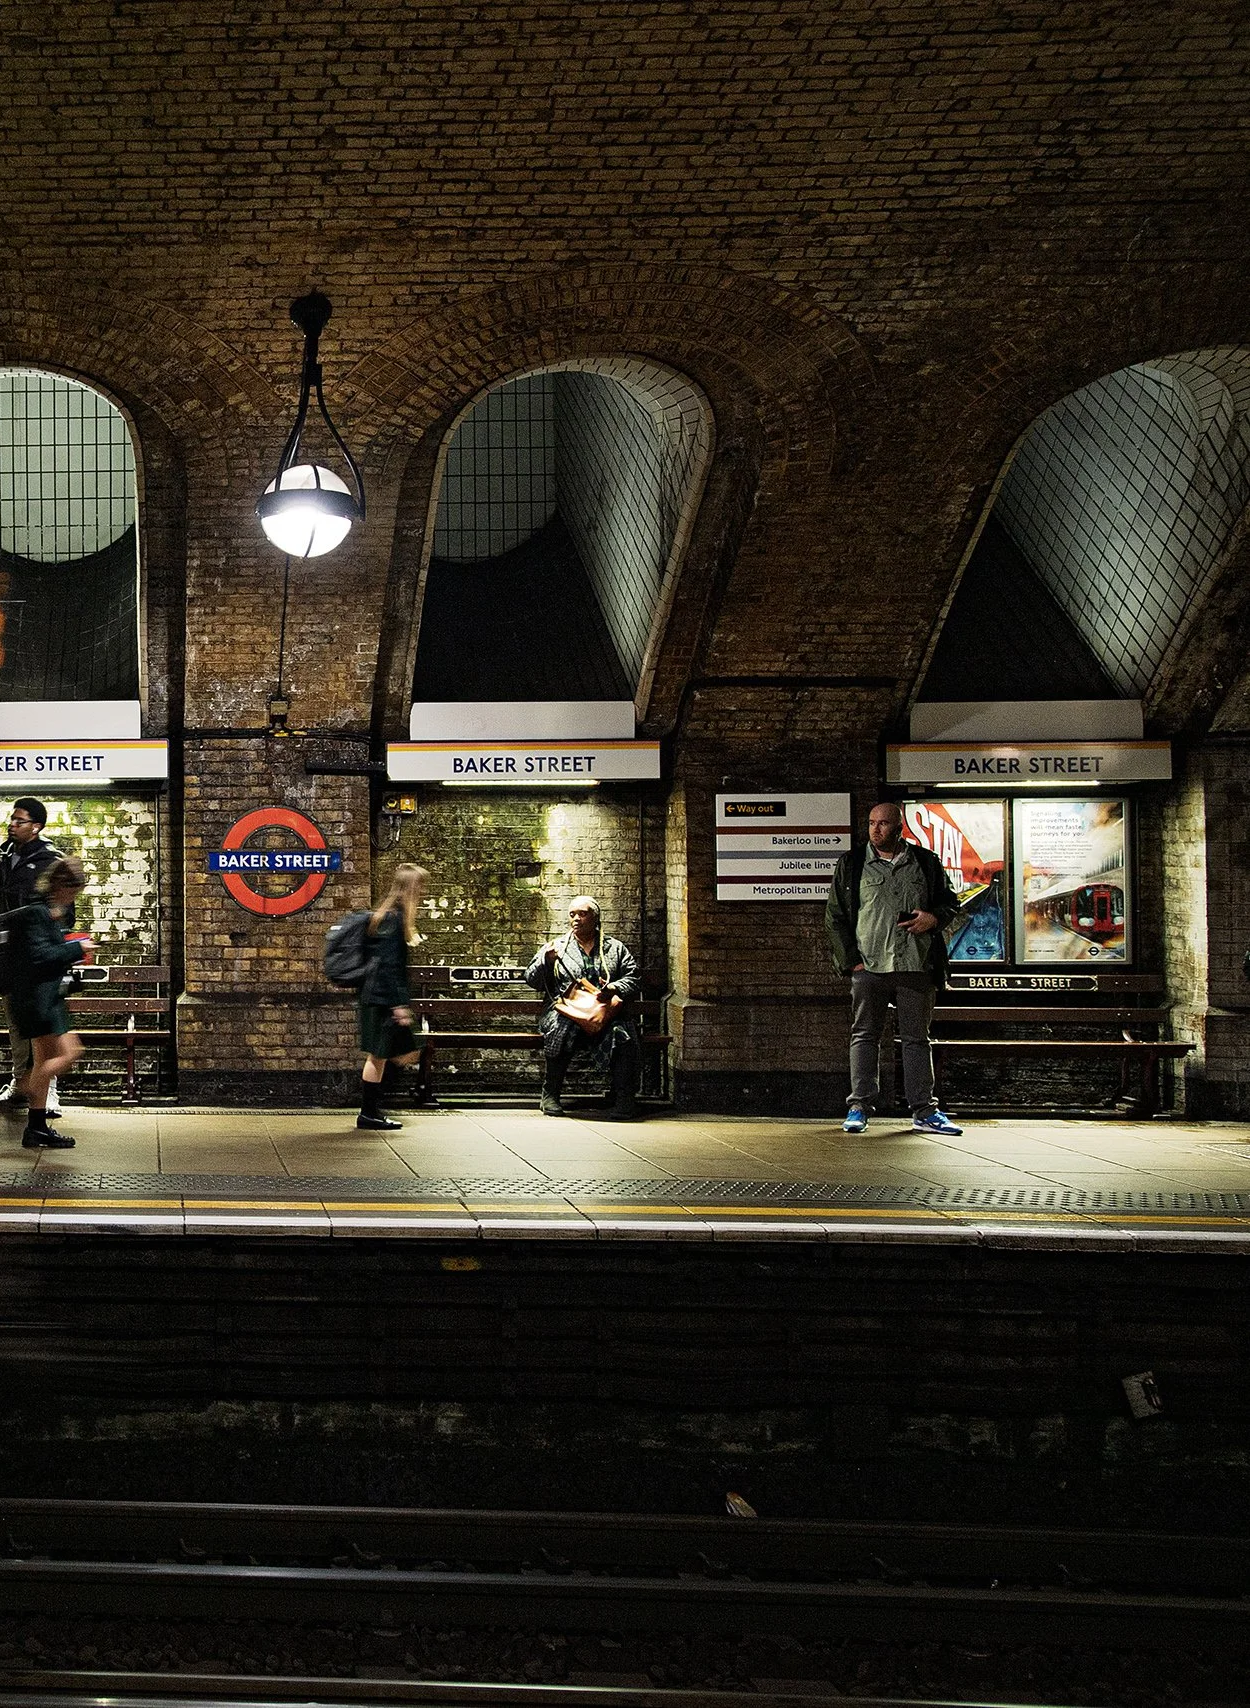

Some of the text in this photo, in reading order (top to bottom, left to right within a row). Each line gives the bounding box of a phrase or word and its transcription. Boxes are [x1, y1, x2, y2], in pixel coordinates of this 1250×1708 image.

[35, 755, 104, 771] STREET
[453, 756, 596, 773] BAKER STREET
[954, 756, 1104, 774] BAKER STREET
[736, 804, 774, 814] Way out
[772, 836, 831, 845] Bakerloo line
[905, 803, 963, 868] STAY
[218, 854, 331, 868] BAKER STREET
[779, 861, 831, 870] Jubilee line
[753, 885, 830, 896] Metropolitan line
[472, 969, 510, 979] BAKER
[969, 977, 1072, 988] BAKER STREET
